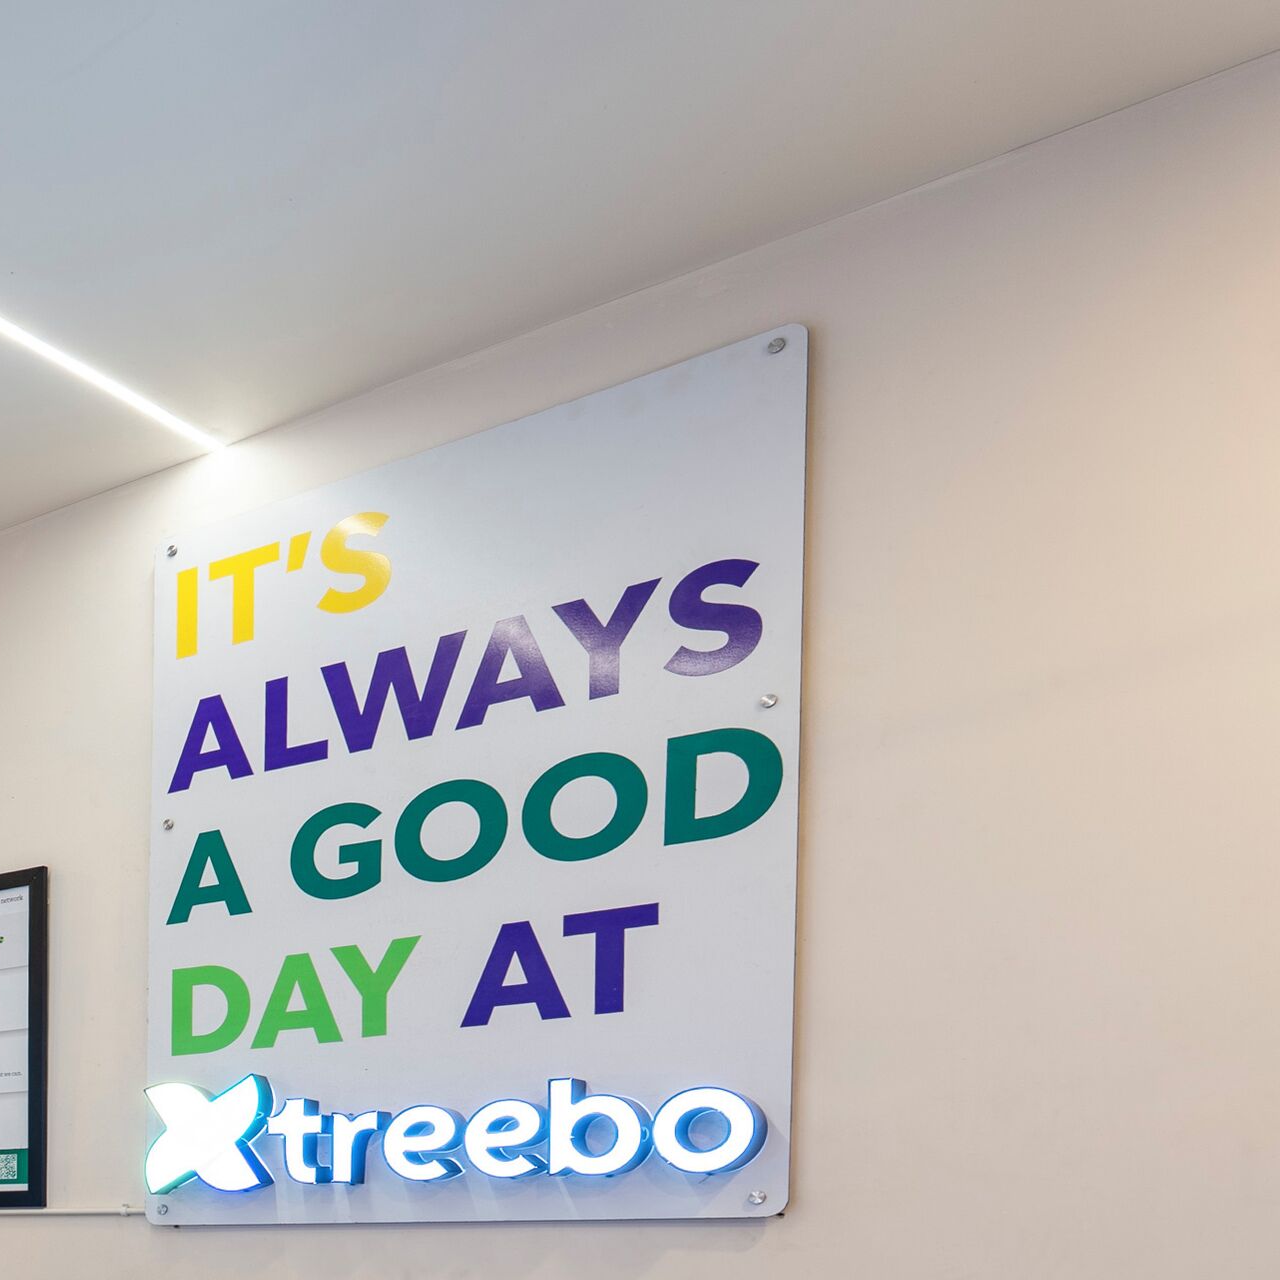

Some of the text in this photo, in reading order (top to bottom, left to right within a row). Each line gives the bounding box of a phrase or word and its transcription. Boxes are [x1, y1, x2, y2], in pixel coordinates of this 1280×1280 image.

[175, 511, 393, 660] IT'S
[167, 558, 763, 794] ALWAYS
[166, 727, 784, 925] A GOOD
[171, 902, 660, 1057] DAY AT
[268, 1077, 767, 1186] treebo
